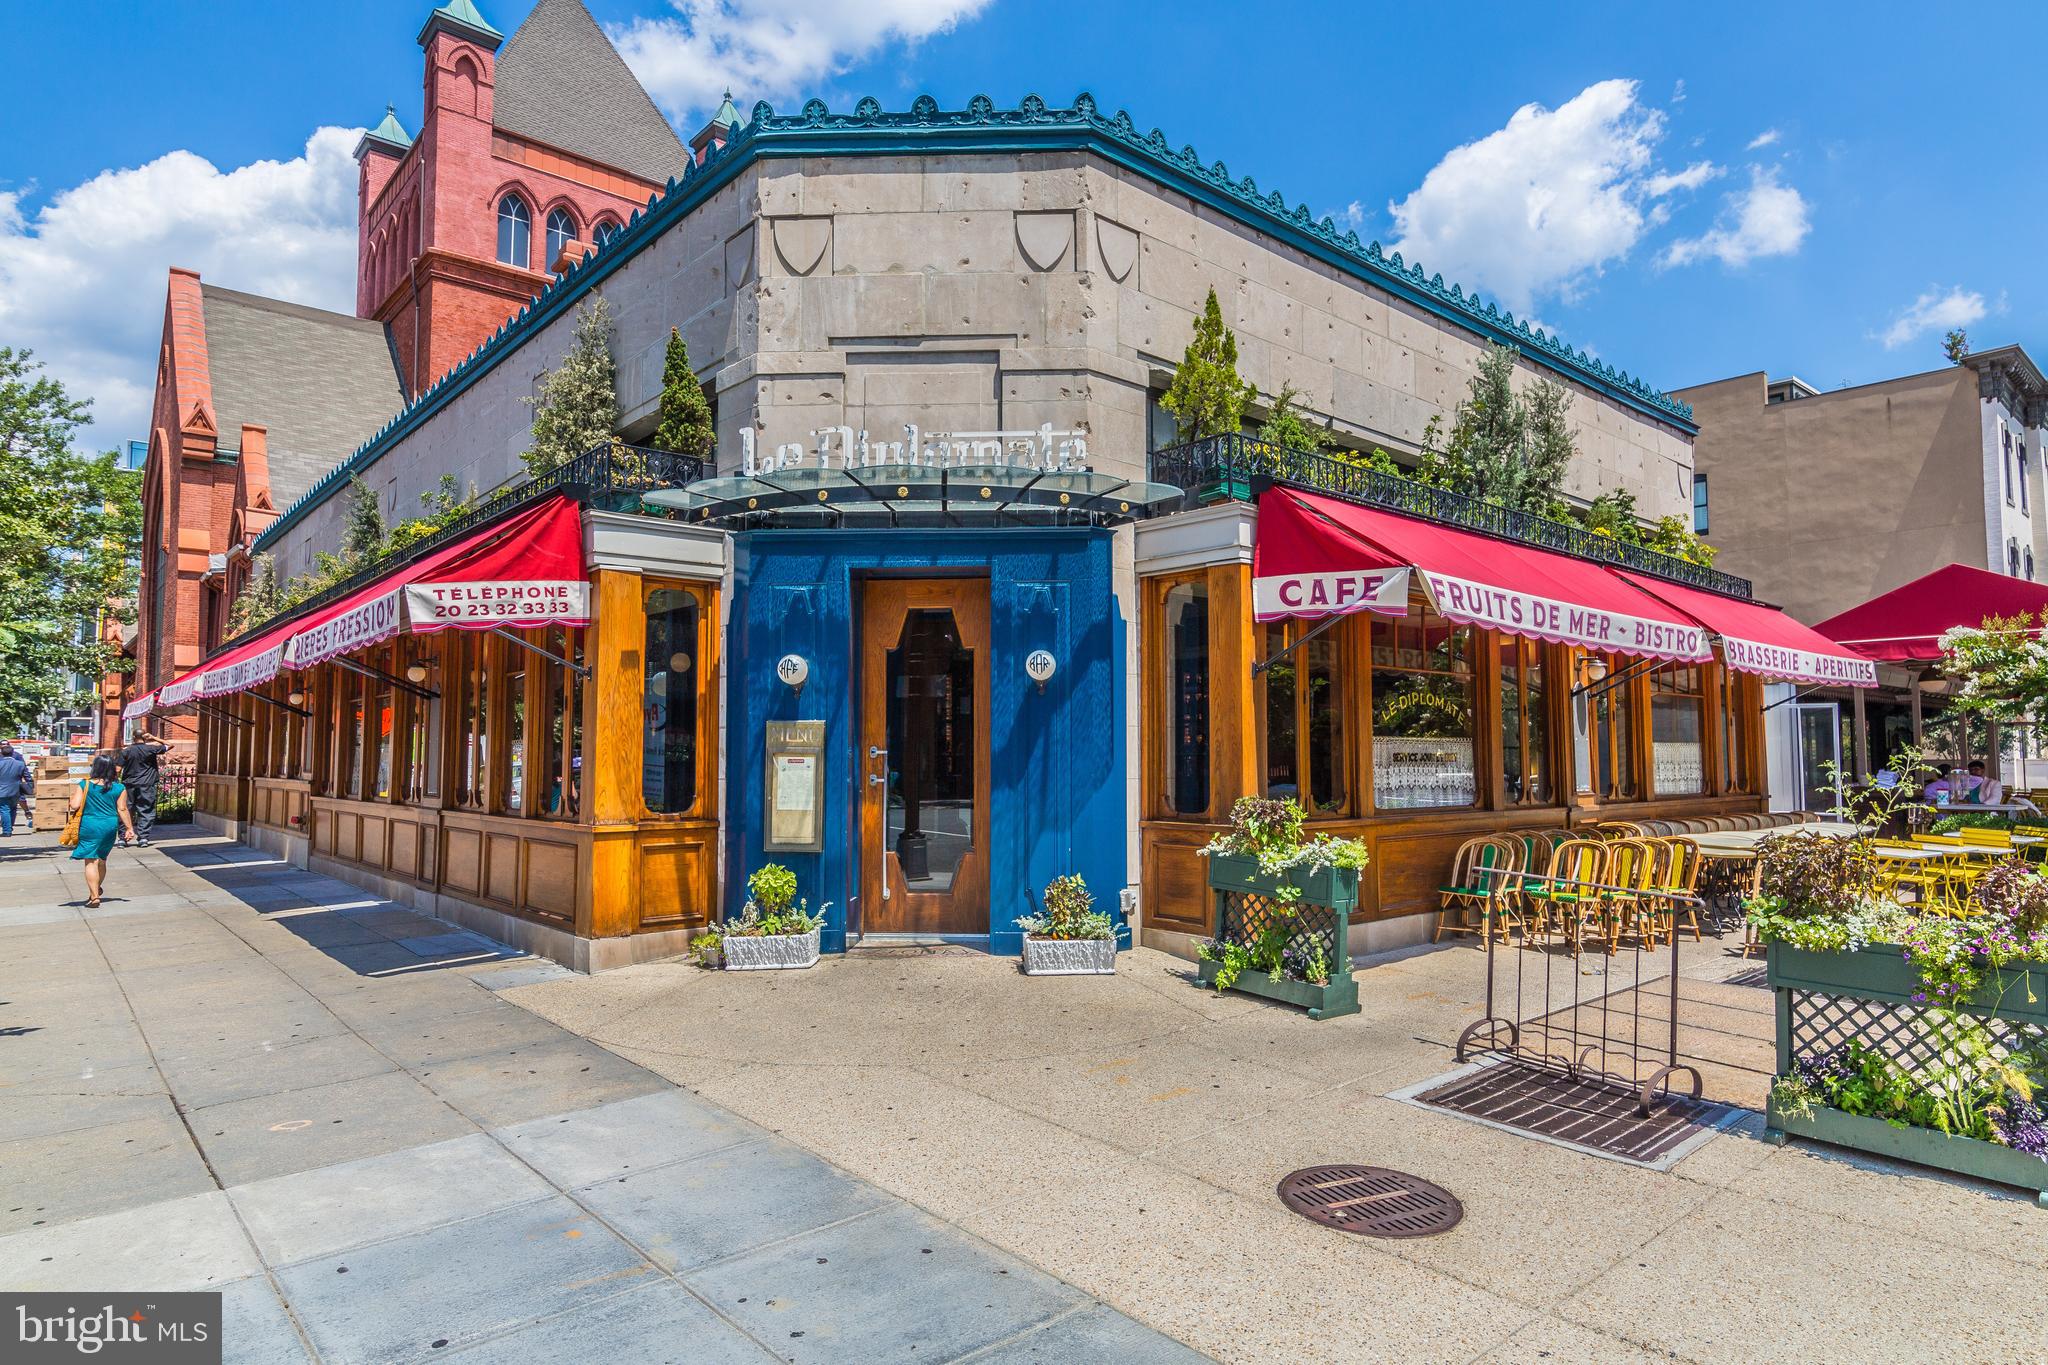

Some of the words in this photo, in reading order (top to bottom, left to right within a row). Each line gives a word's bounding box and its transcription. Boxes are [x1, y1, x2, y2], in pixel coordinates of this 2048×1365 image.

[738, 426, 803, 477] Le
[432, 586, 568, 601] TÉLÉPHONE
[1278, 575, 1384, 607] CAFE
[333, 595, 395, 646] PRESSION
[434, 605, 461, 617] 20
[468, 604, 490, 617] 23
[495, 603, 518, 616] 32
[523, 602, 546, 614] 33
[550, 601, 569, 613] 33
[1429, 576, 1523, 624] FRUITS
[1532, 600, 1561, 631] DE
[1569, 608, 1611, 640] MER
[1634, 621, 1698, 651] BISTRO
[1028, 653, 1051, 675] BAR
[1728, 640, 1799, 672] BRASSERIE
[1381, 701, 1398, 721] LE
[1398, 691, 1466, 726] DIPLOMATE
